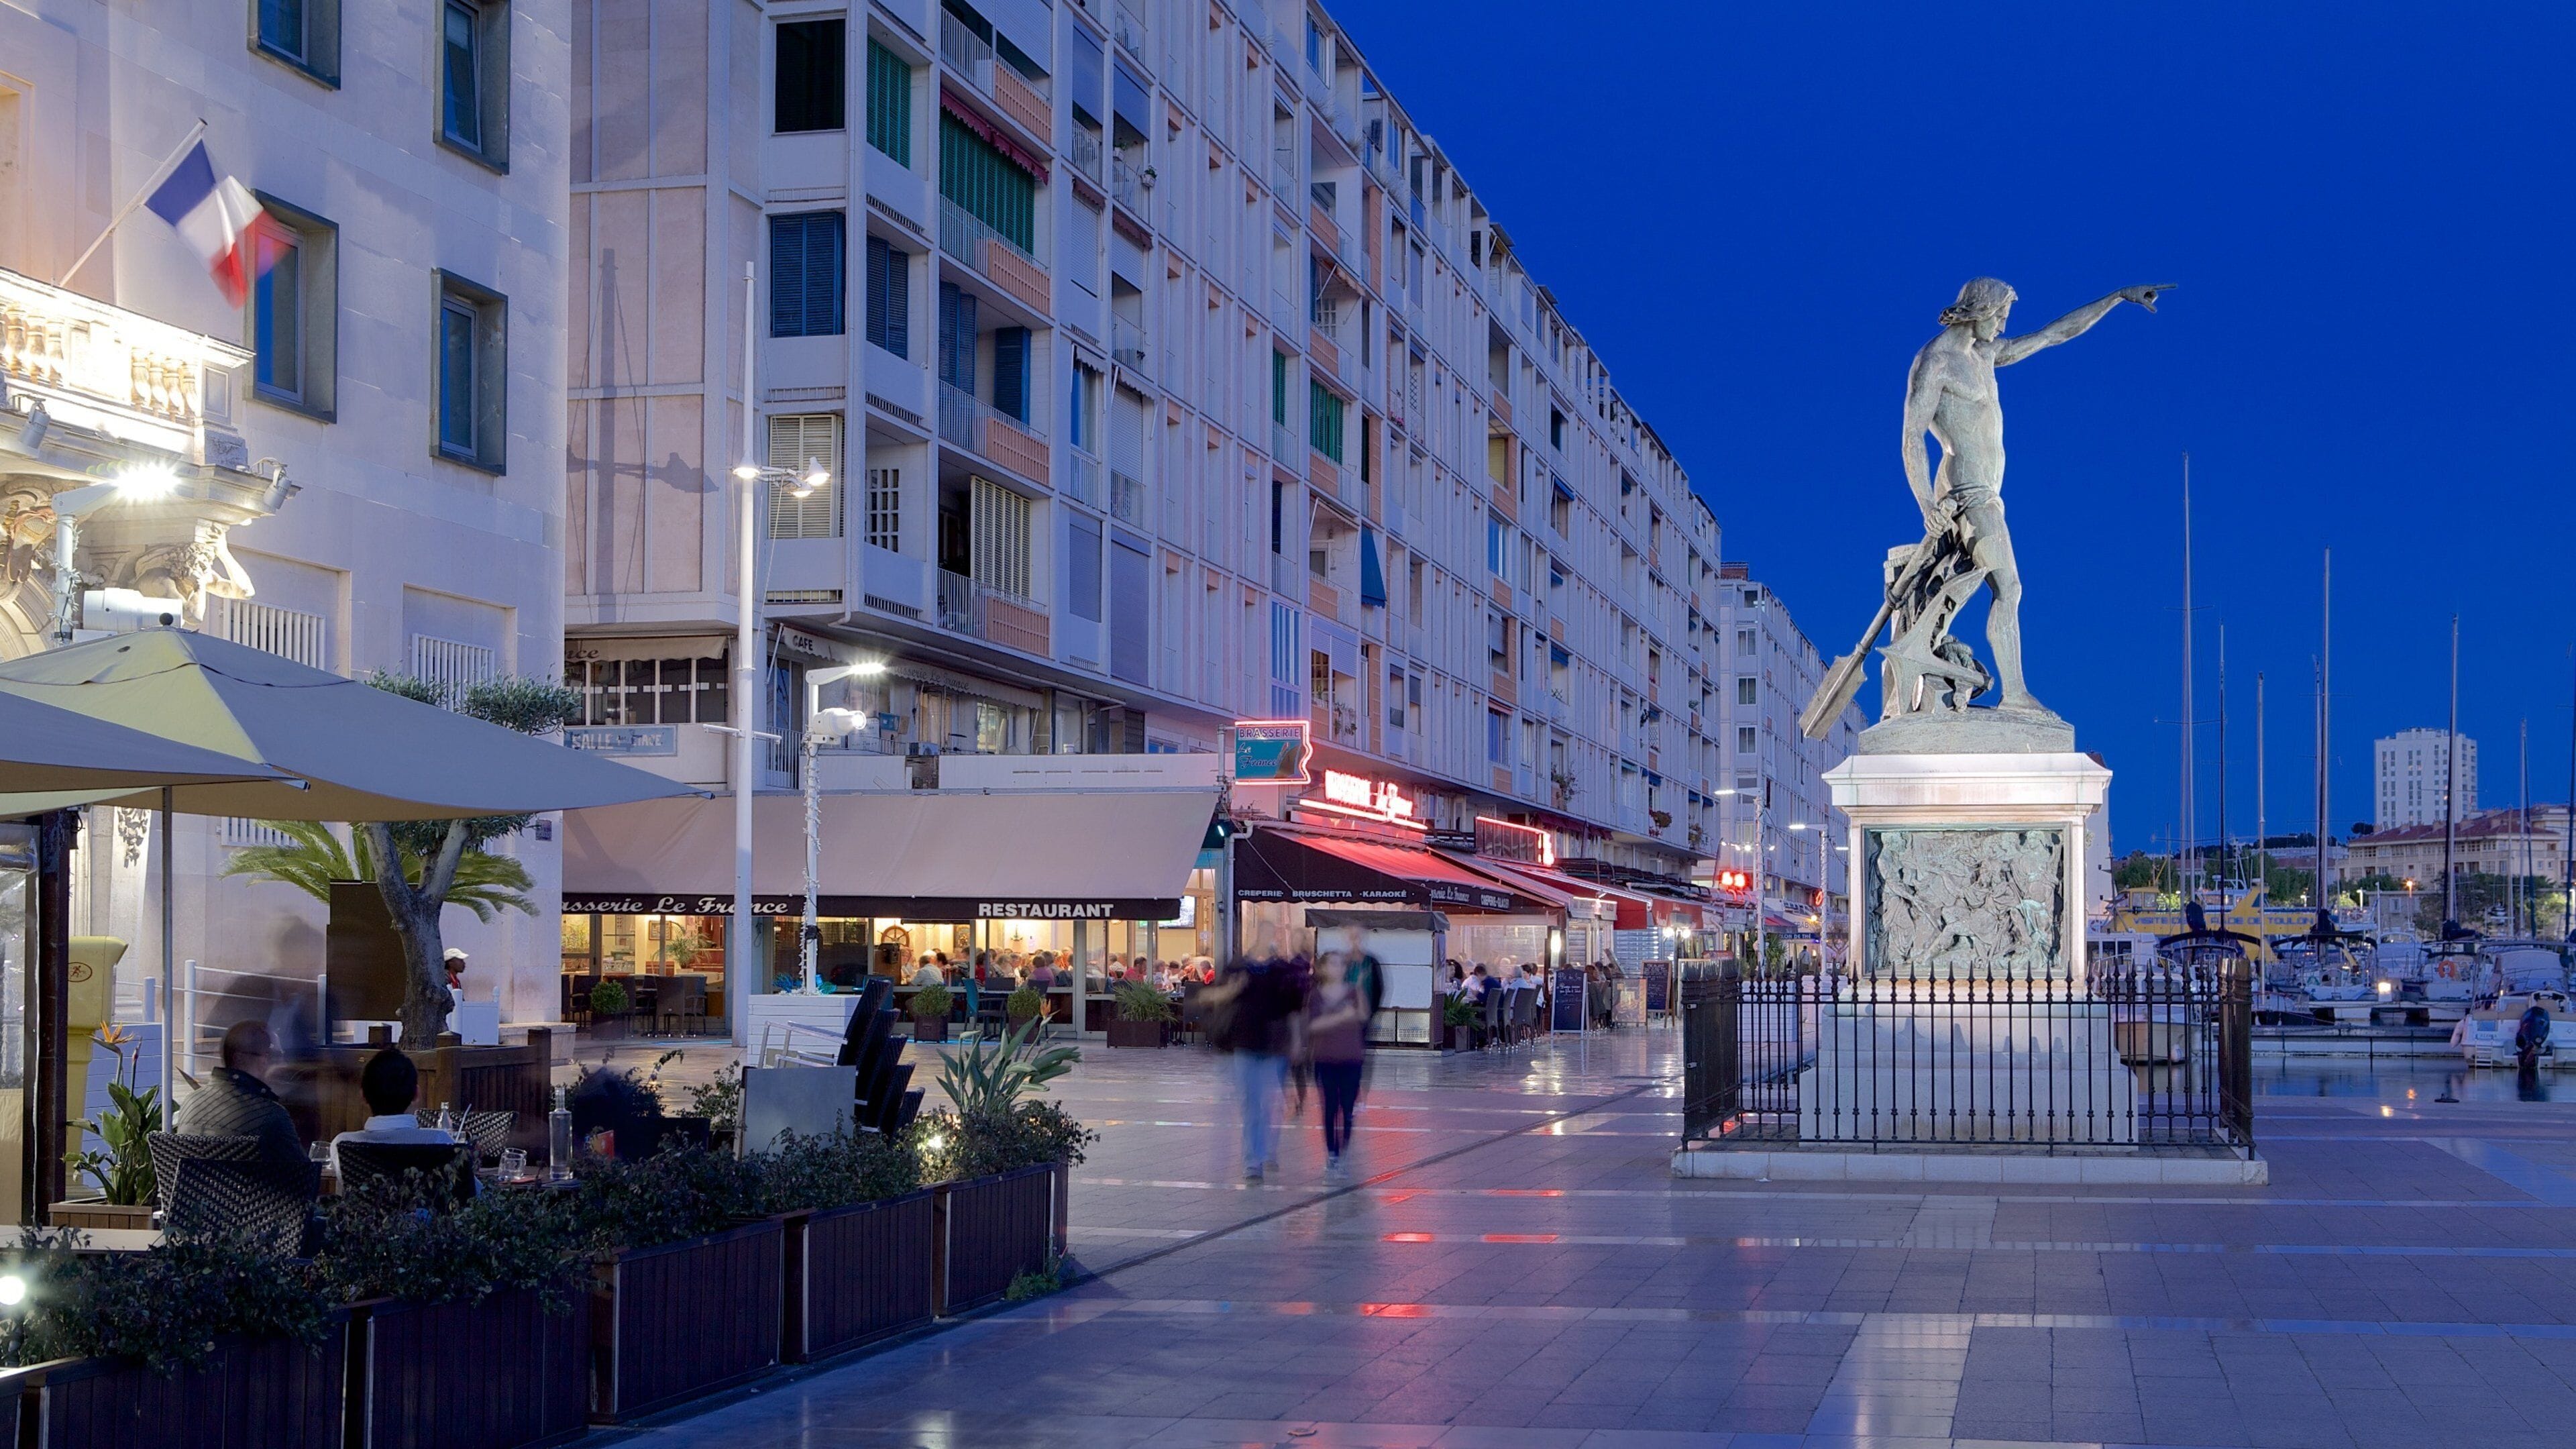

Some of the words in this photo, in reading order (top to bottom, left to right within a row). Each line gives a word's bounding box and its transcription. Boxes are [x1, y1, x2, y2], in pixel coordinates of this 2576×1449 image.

[793, 635, 813, 651] CAFE
[1239, 728, 1300, 738] BRASSERIE
[571, 733, 614, 751] SALLE
[1238, 742, 1251, 753] Le
[1239, 755, 1277, 769] France
[1362, 889, 1407, 898] KARAOKÉ
[651, 896, 686, 913] Le
[979, 903, 1114, 917] RESTAURANT
[2133, 916, 2168, 924] VISITE
[2267, 916, 2314, 924] TOULON
